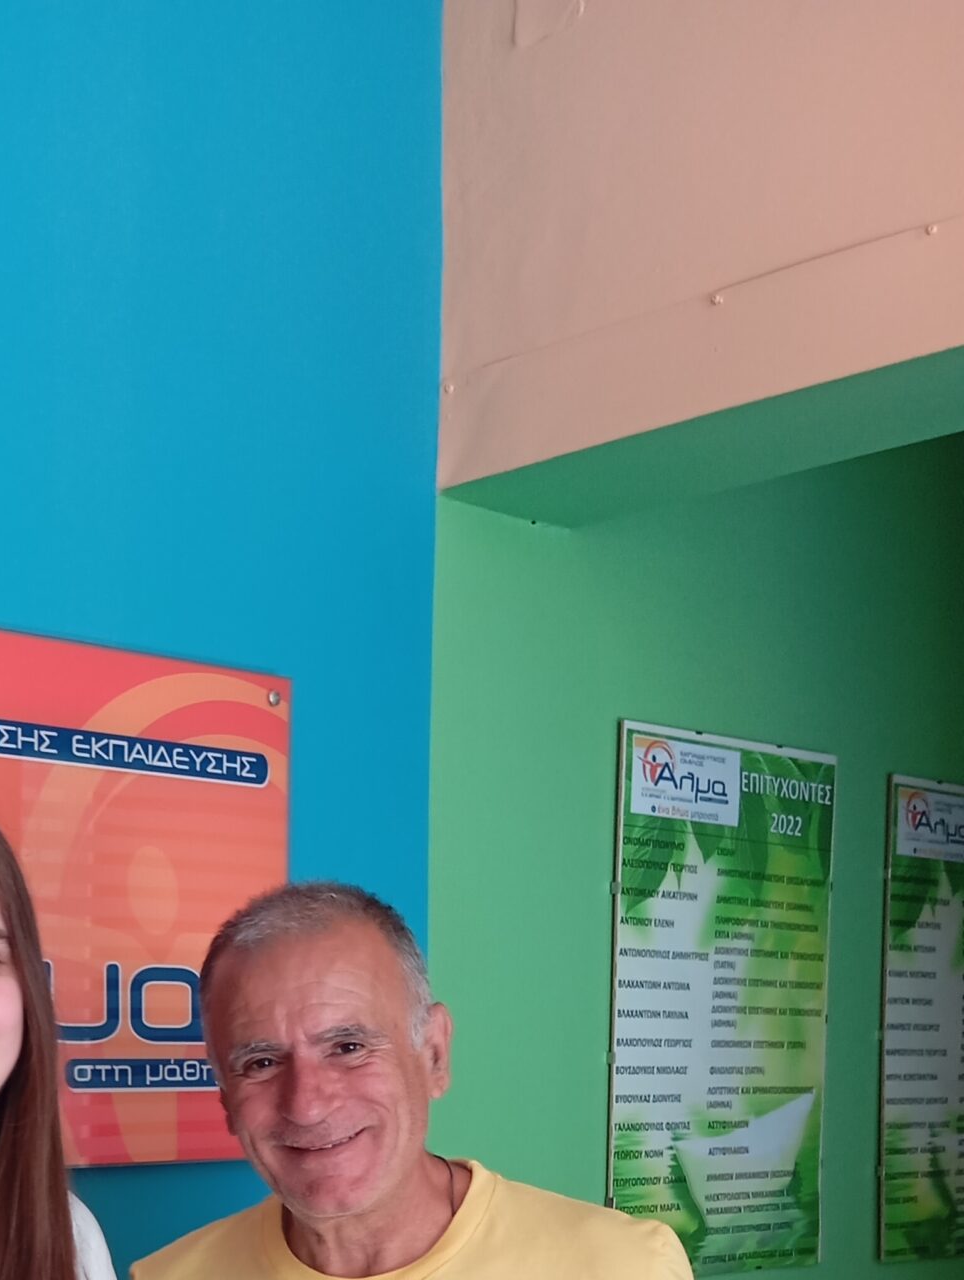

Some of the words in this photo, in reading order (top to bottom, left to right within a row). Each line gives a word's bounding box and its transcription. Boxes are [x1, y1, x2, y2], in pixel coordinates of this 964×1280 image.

[72, 735, 257, 778] ΕΚΠΑΙΔΕΥΣΗΣ
[742, 771, 832, 805] ΕΠΙΤΥΧΟΝΤΕΣ
[770, 813, 802, 836] 2022
[74, 1064, 132, 1085] στη
